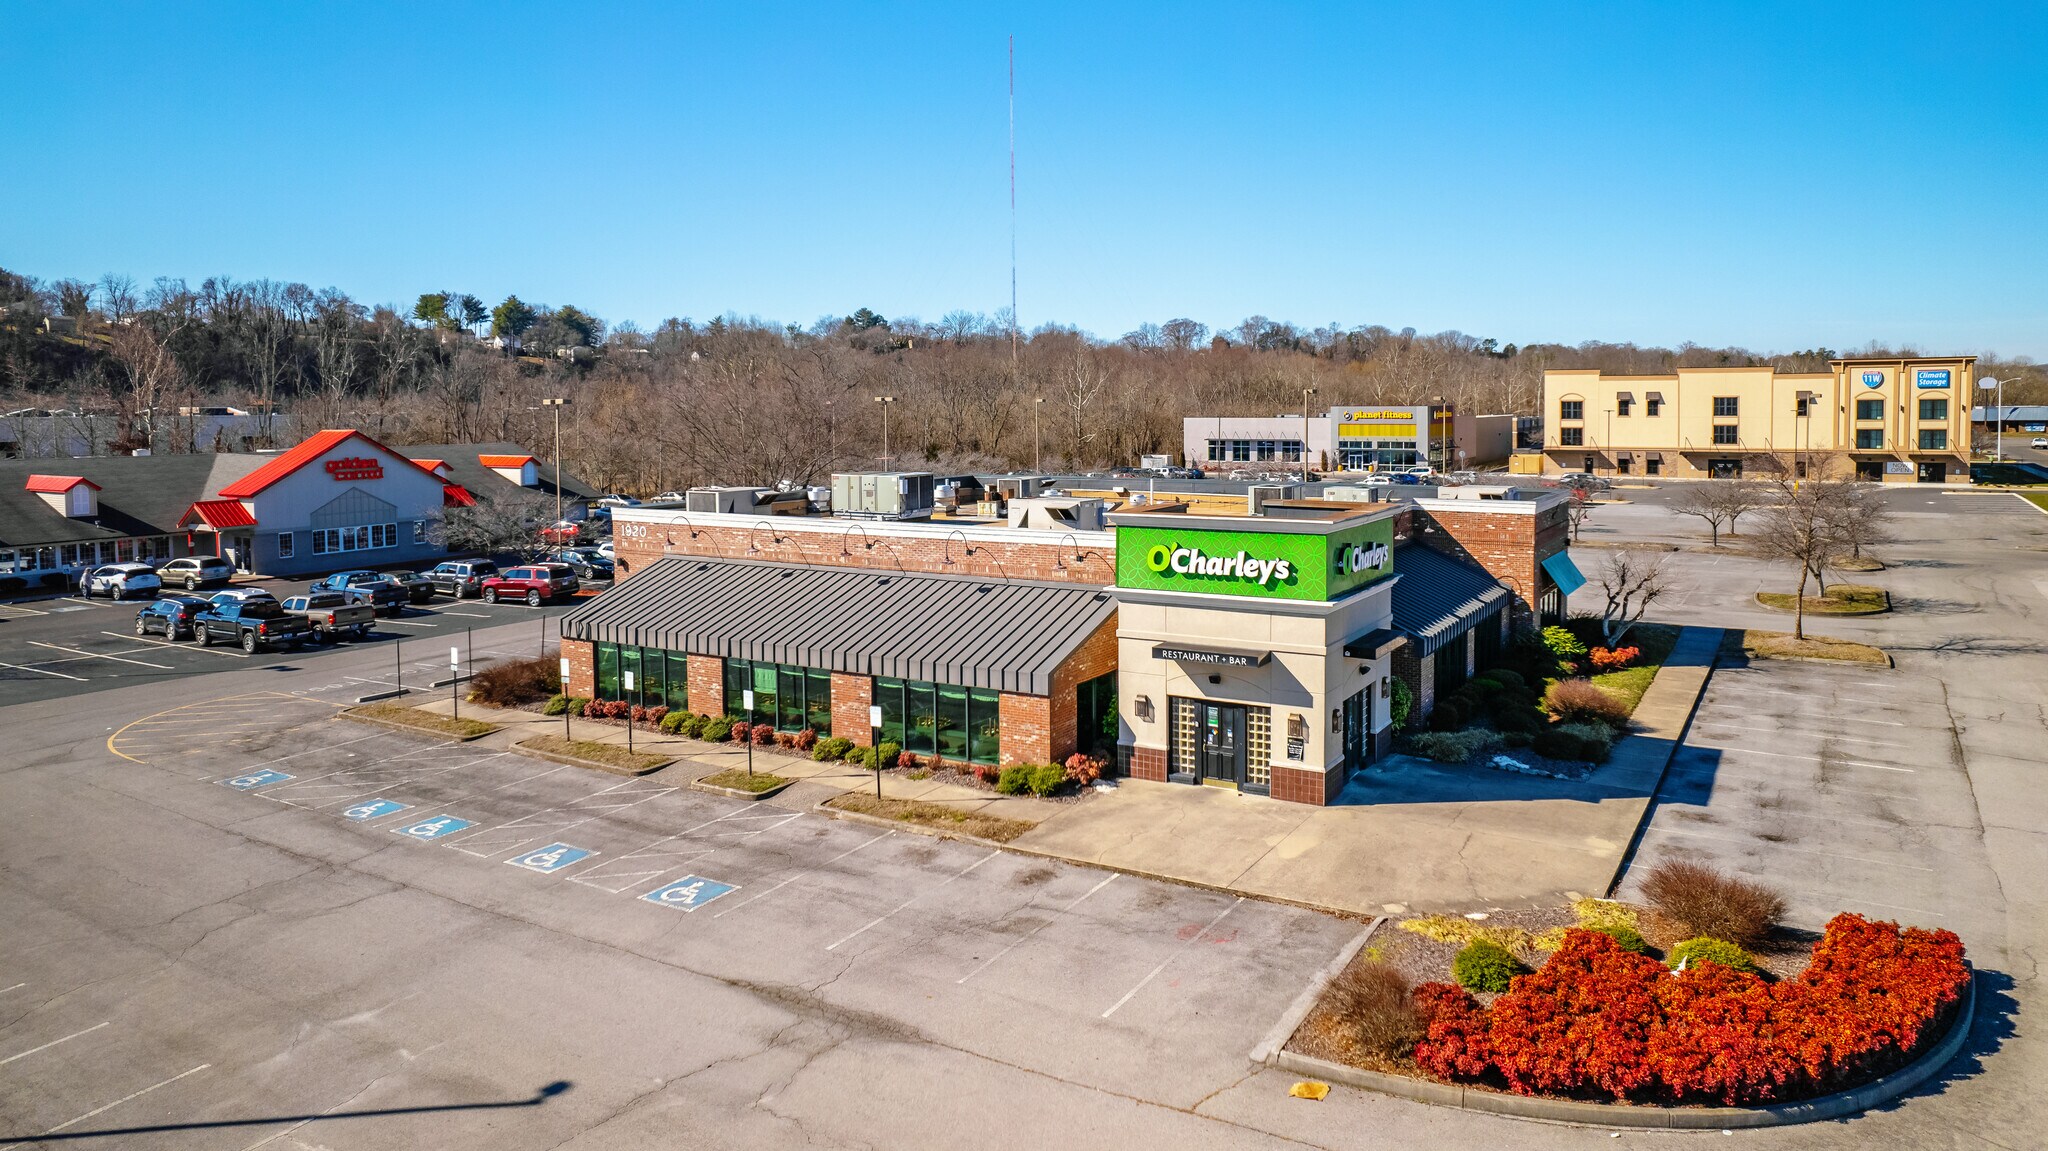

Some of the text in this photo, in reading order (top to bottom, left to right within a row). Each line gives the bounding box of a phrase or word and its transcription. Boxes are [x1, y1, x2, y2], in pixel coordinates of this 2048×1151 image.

[1864, 375, 1881, 383] 11W
[1919, 379, 1946, 387] Storage
[1354, 411, 1412, 420] planet fitness
[621, 524, 647, 538] 1920
[1147, 541, 1290, 585] O'Charley's
[1343, 541, 1389, 576] O'Charley's
[1162, 650, 1219, 663] RESTAURANT
[1229, 656, 1247, 666] BAR
